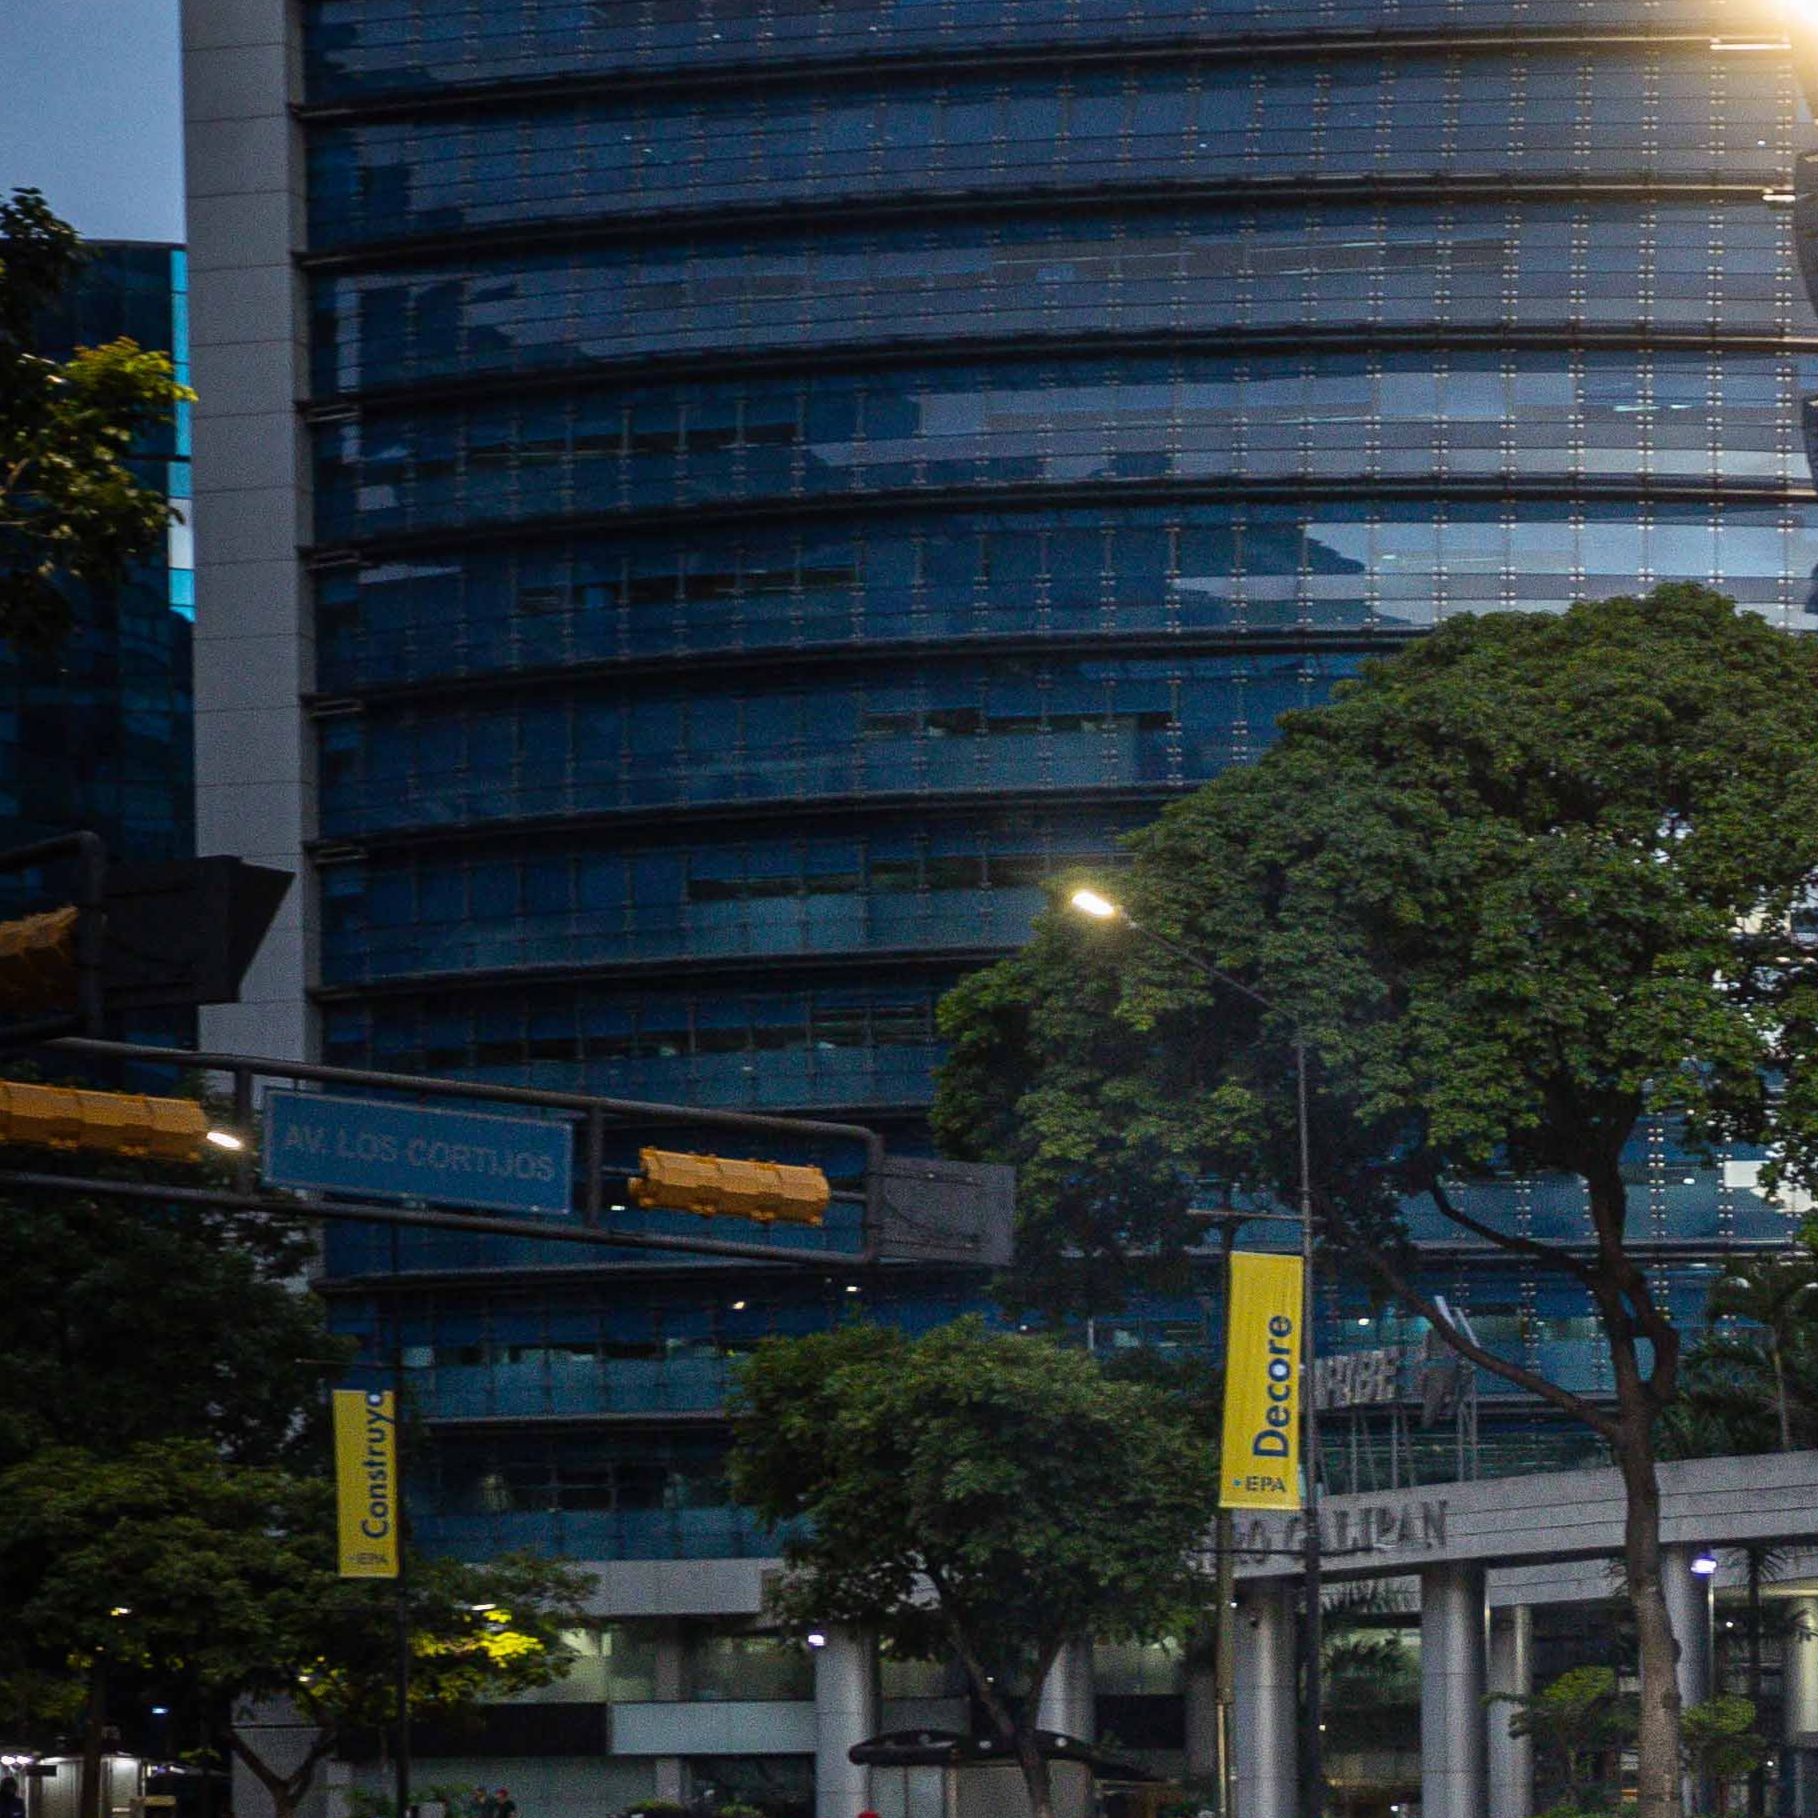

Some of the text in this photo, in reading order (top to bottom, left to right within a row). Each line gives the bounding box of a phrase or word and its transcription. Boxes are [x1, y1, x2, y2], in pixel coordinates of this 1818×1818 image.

[282, 1124, 557, 1182] AV. LOS CORTIJOS
[1252, 1314, 1293, 1459] Decore
[1245, 1476, 1287, 1493] EPA
